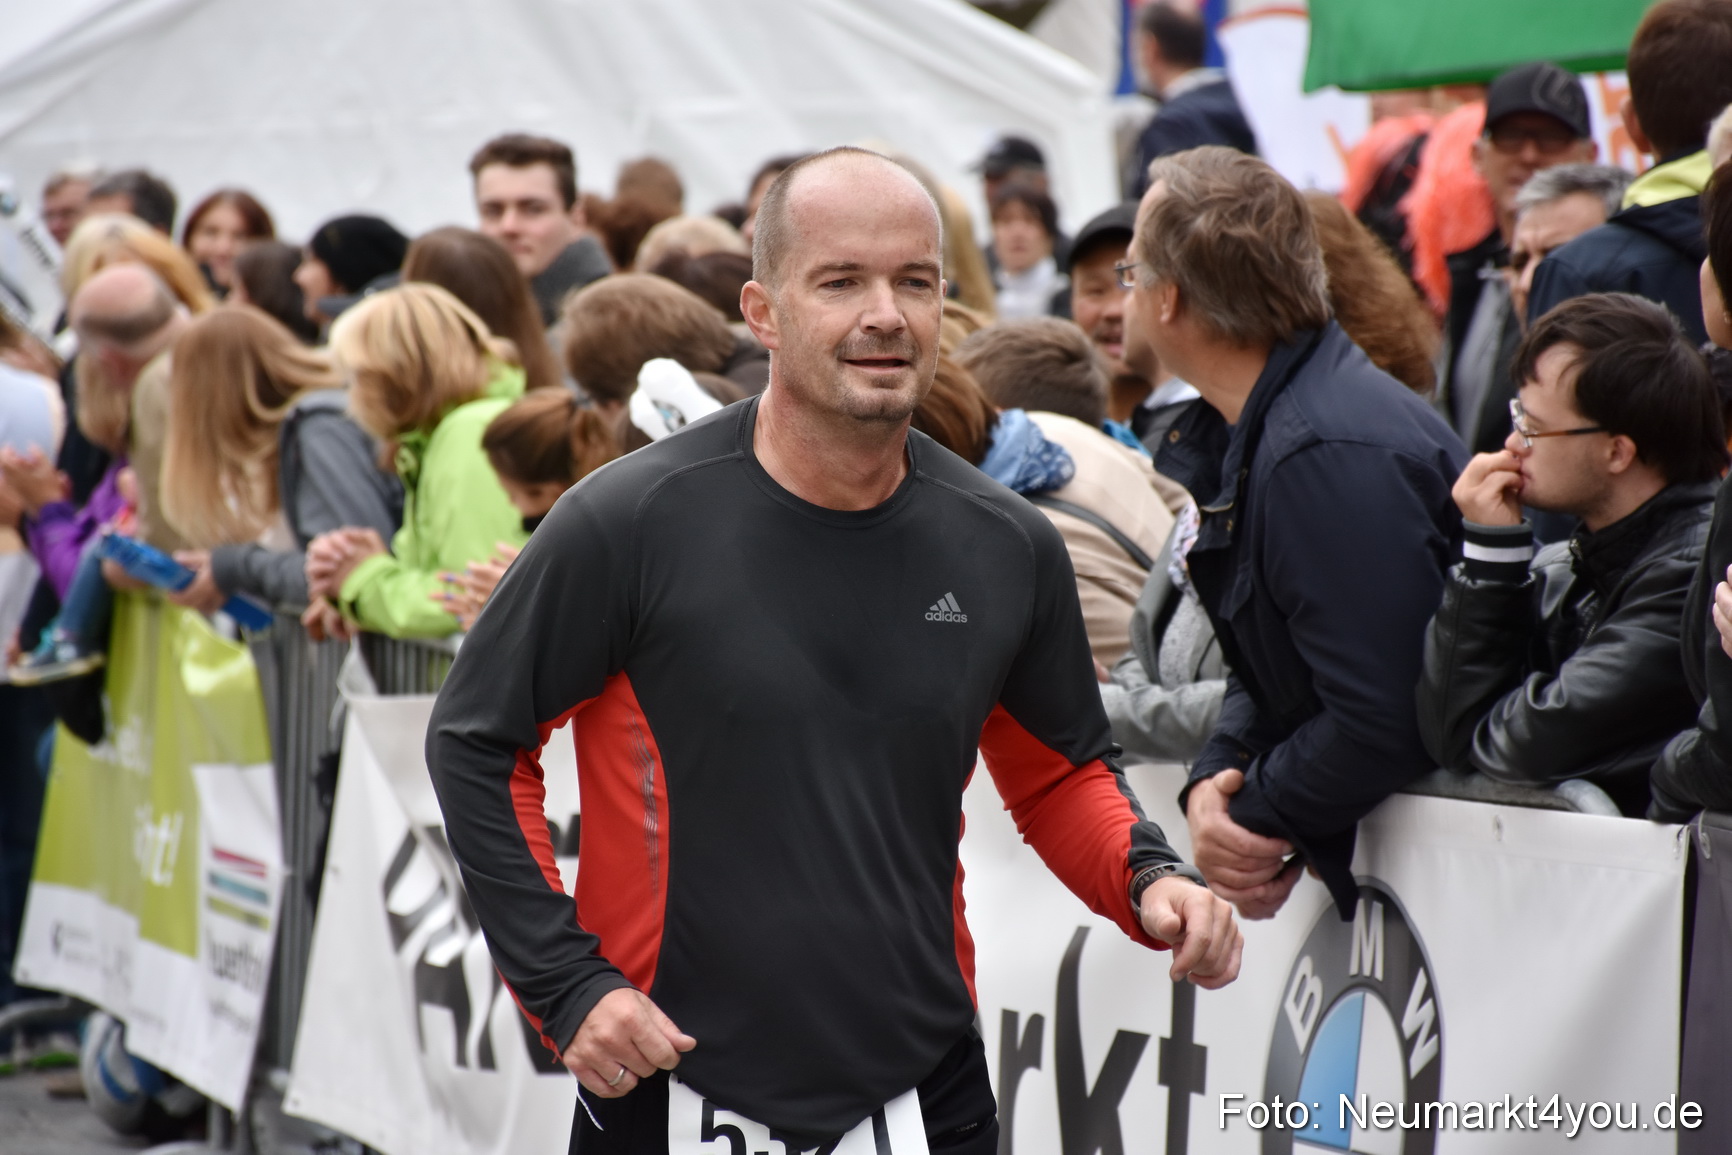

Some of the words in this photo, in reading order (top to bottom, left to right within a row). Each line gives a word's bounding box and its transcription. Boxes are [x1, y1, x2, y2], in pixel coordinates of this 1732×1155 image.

[924, 610, 968, 623] adidas
[976, 925, 1208, 1155] rkt
[1284, 898, 1438, 1080] BMW
